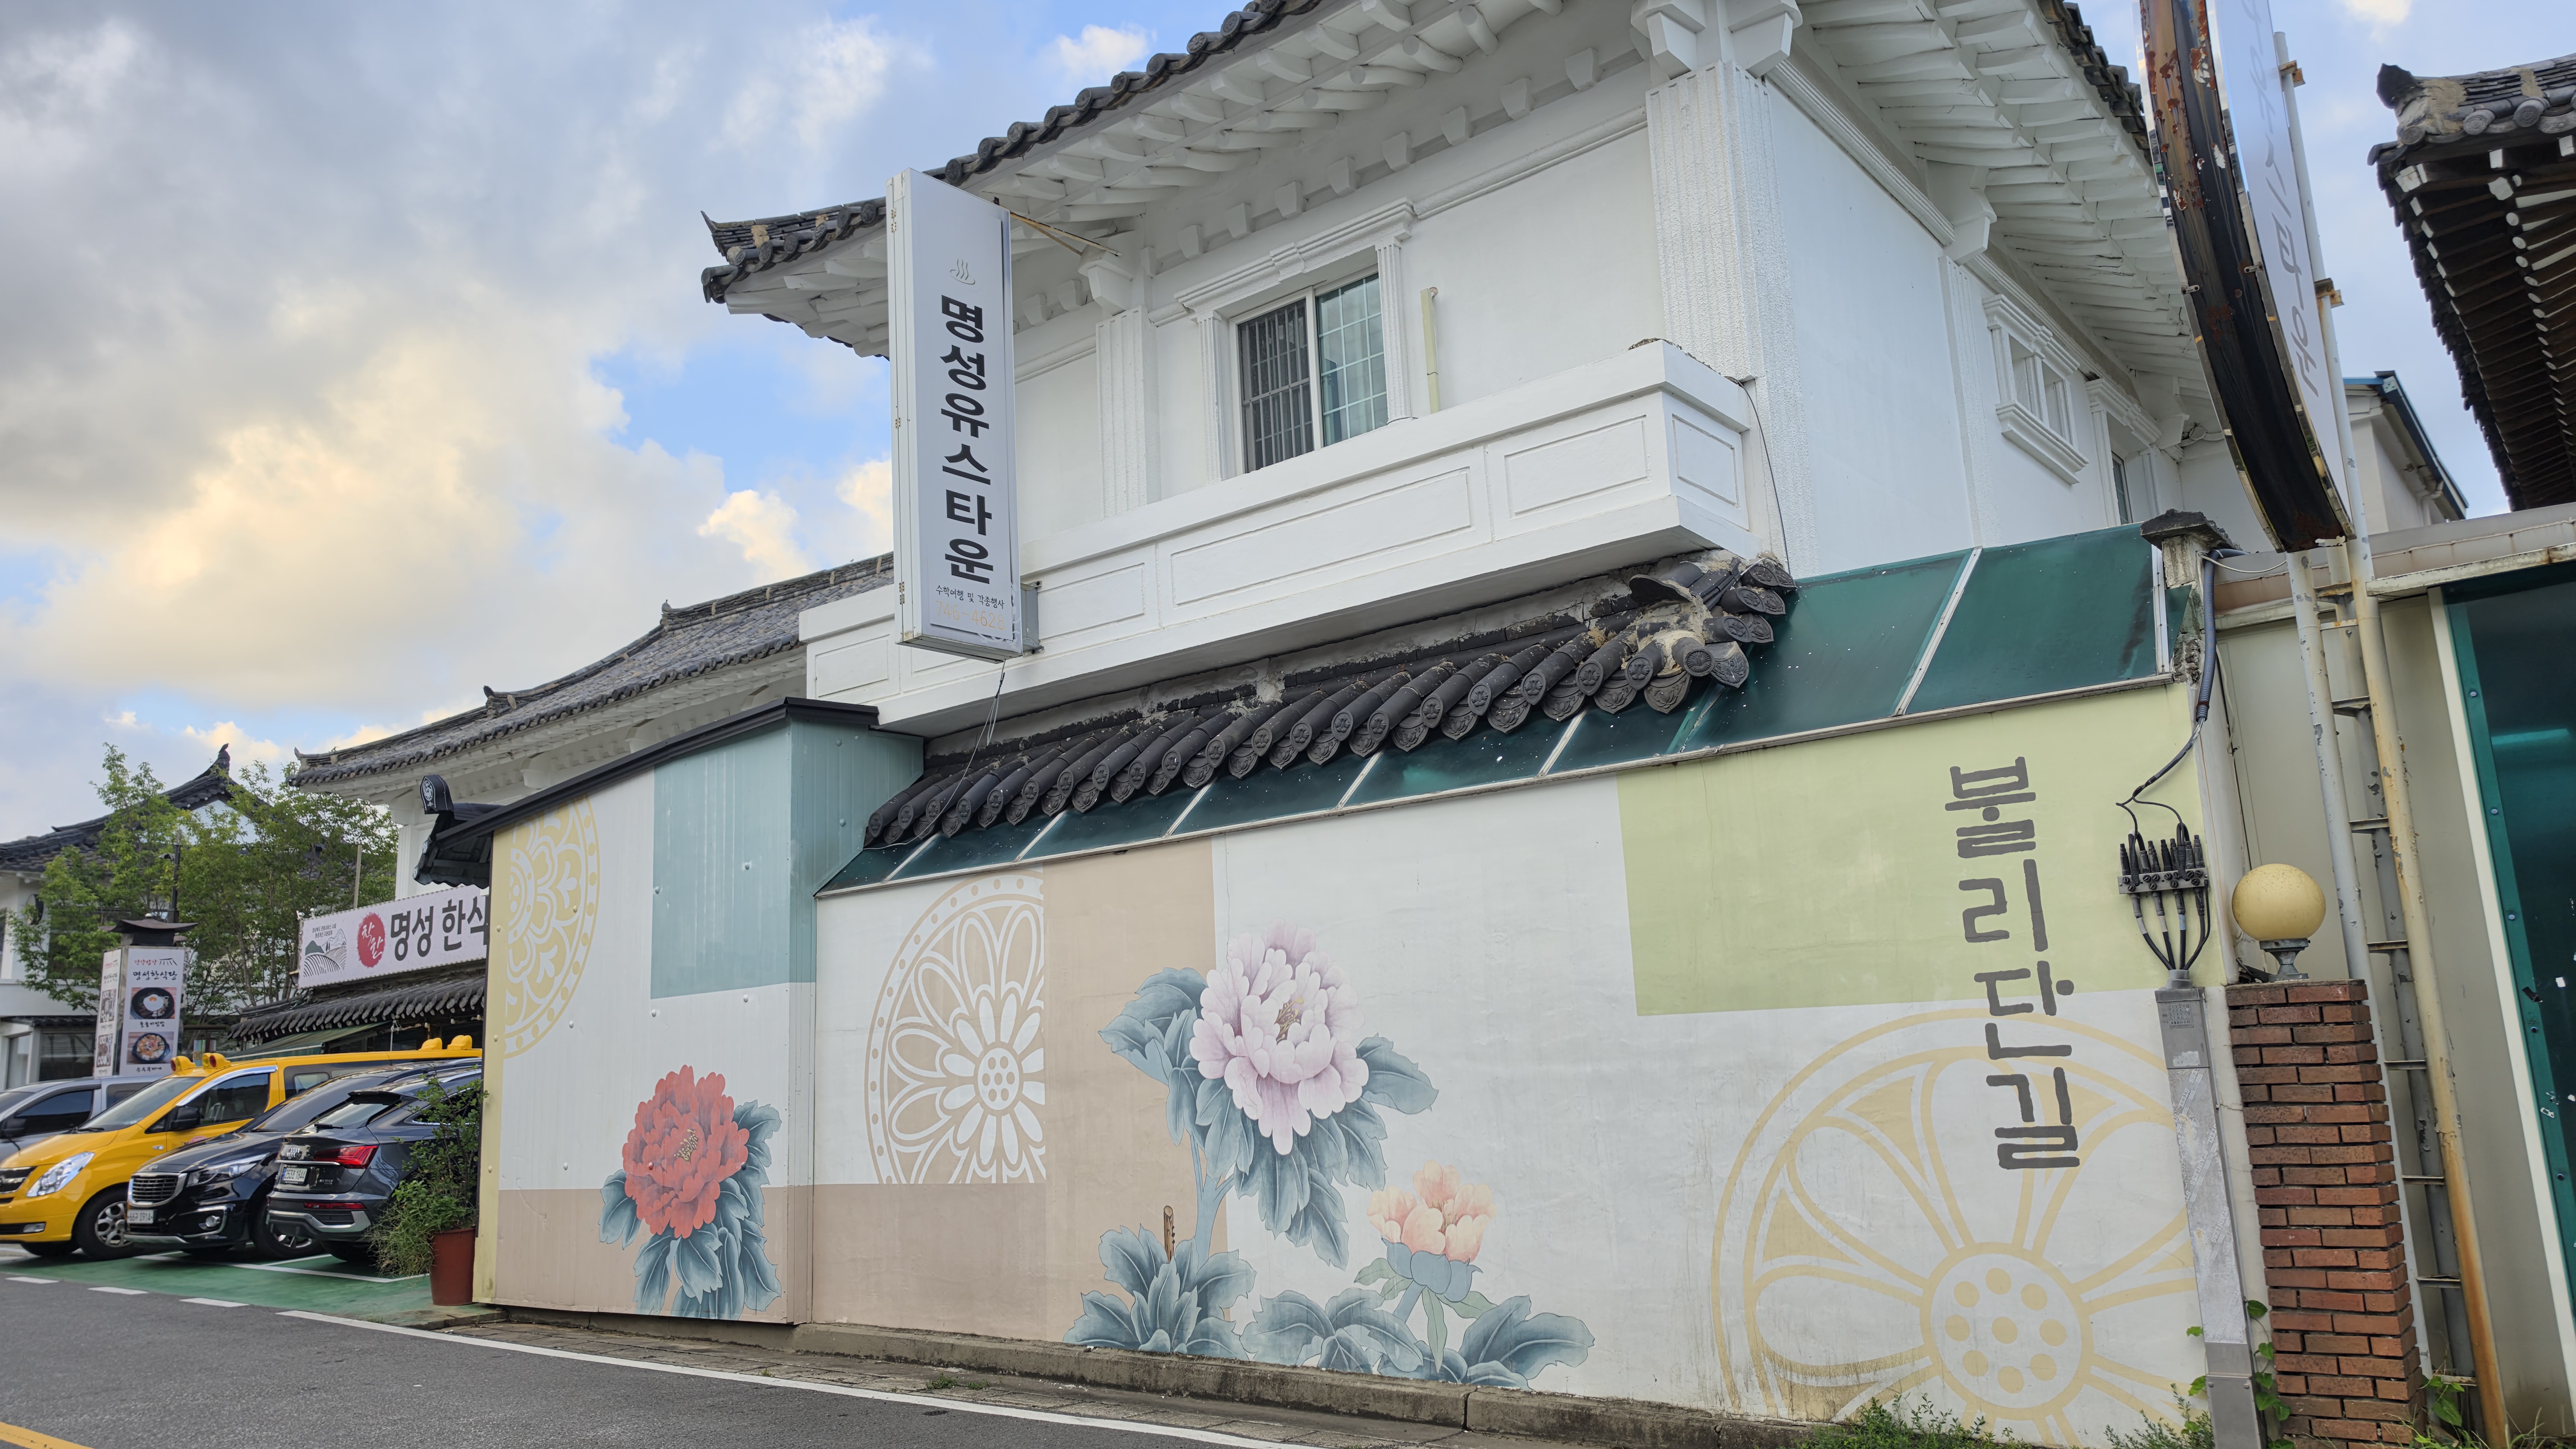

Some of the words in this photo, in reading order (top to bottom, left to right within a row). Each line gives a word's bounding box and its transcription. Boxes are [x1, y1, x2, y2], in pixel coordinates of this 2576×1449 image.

[940, 294, 994, 584] 명성유스타운
[936, 585, 964, 600] 수학여행
[967, 592, 974, 603] 및
[977, 595, 1004, 609] 각종행사
[935, 600, 1005, 630] 746-4628
[391, 906, 434, 961] 명성
[442, 896, 490, 951] 한식
[133, 970, 177, 980] 명성한식당
[1945, 756, 2080, 1169] 불리단길
[2190, 1149, 2208, 1186] STAINLESS
[139, 1212, 151, 1222] 0914
